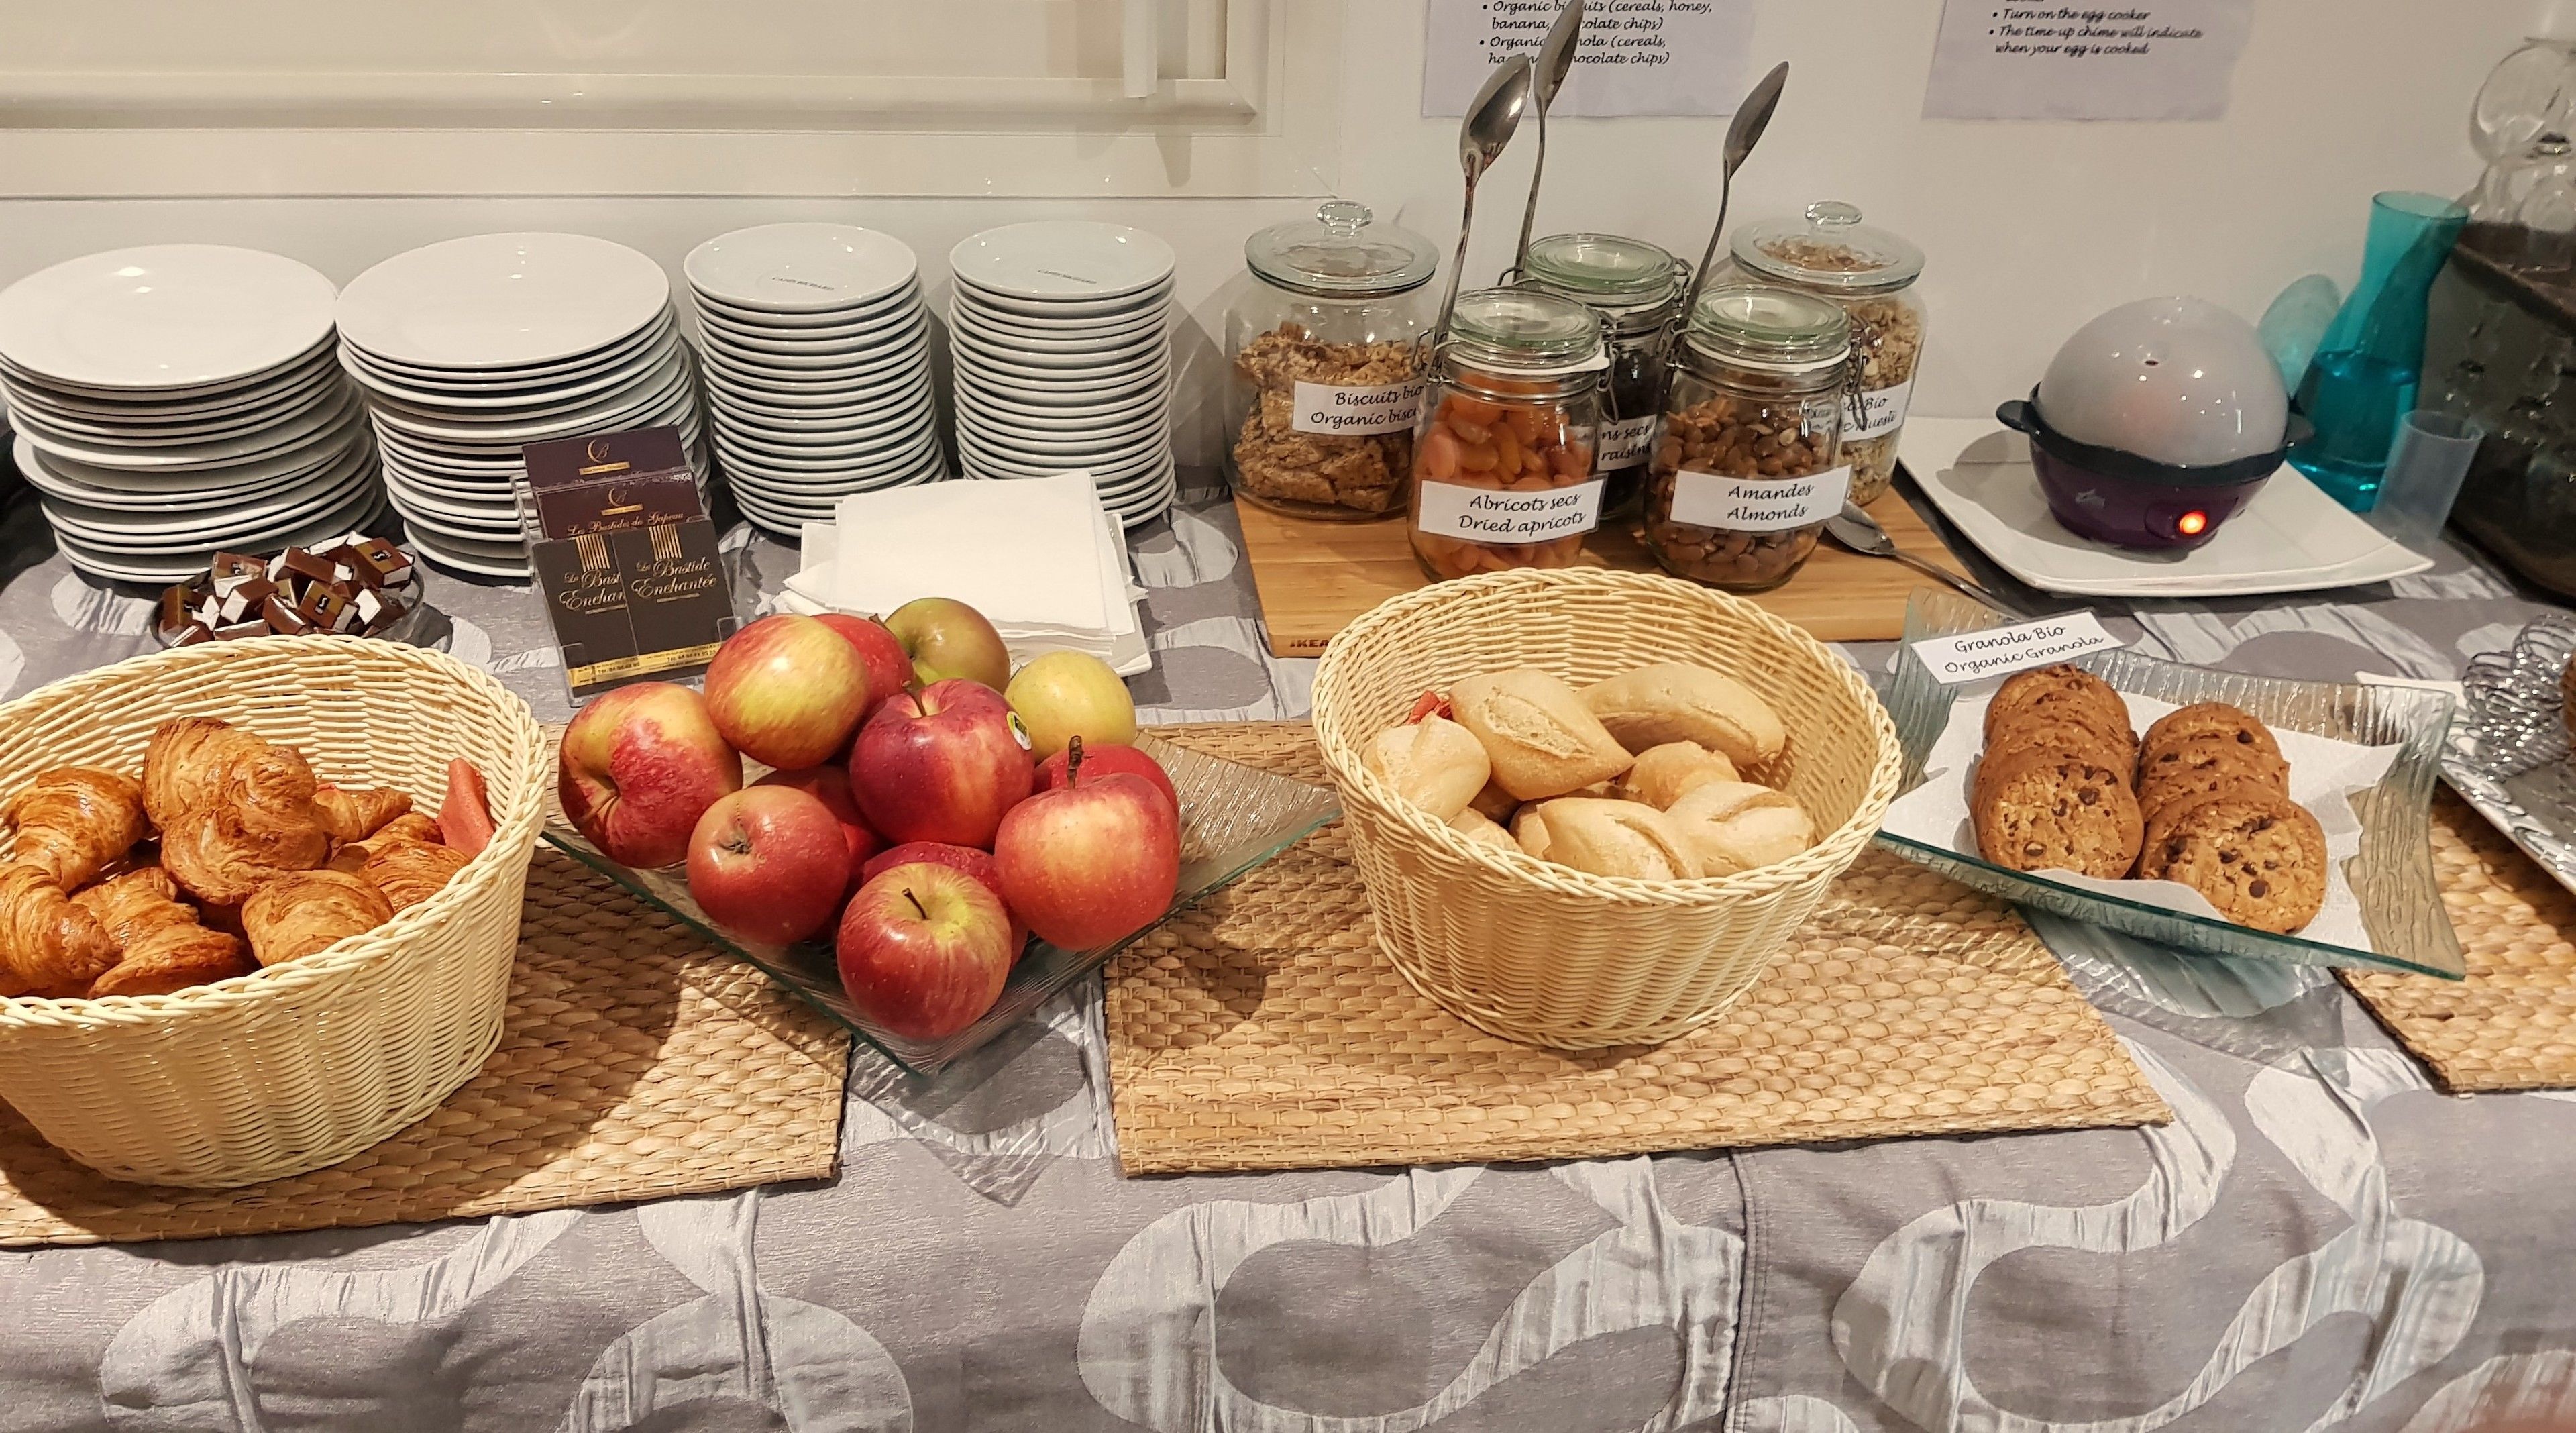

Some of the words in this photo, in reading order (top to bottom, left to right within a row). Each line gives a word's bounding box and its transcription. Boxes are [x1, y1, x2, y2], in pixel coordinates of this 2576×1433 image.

[1493, 1, 1552, 15] Organic
[1609, 0, 1664, 13] (cereals,
[1669, 0, 1712, 14] honey,
[2003, 8, 2035, 19] Turn
[2037, 11, 2055, 19] on
[2057, 7, 2080, 19] the
[2081, 10, 2105, 23] egg
[2107, 8, 2151, 19] cooker
[1492, 17, 1550, 30] banana,
[1623, 17, 1663, 32] chips)
[2000, 24, 2023, 36] The
[2077, 25, 2116, 37] chime
[2120, 25, 2145, 37] will
[2147, 25, 2203, 38] indicate
[1490, 36, 1545, 50] Organic
[1611, 34, 1666, 48] (cereals,
[1995, 41, 2029, 53] when
[2028, 44, 2063, 56] your
[2063, 45, 2088, 58] egg
[2090, 44, 2102, 54] is
[2103, 42, 2151, 54] cooked
[1630, 52, 1670, 66] chips)
[1335, 391, 1401, 407] Biscuits
[1403, 386, 1424, 399] bio
[1864, 397, 1889, 411] Bio
[1311, 411, 1387, 429] Organic
[1856, 410, 1898, 431] uesli
[1728, 483, 1814, 500] Amandes
[1470, 494, 1549, 513] Abricots
[1550, 493, 1582, 511] secs
[1727, 503, 1809, 521] Almonds
[1458, 515, 1515, 533] Dried
[1517, 511, 1587, 537] apricots
[652, 557, 711, 578] Bastide
[581, 570, 621, 589] Bast
[631, 573, 717, 598] Enchantée
[1289, 639, 1329, 648] IKEA
[1955, 631, 2032, 653] Granola
[2032, 626, 2066, 639] Bio
[1945, 653, 2023, 674] Organic
[2026, 637, 2104, 658] Granola
